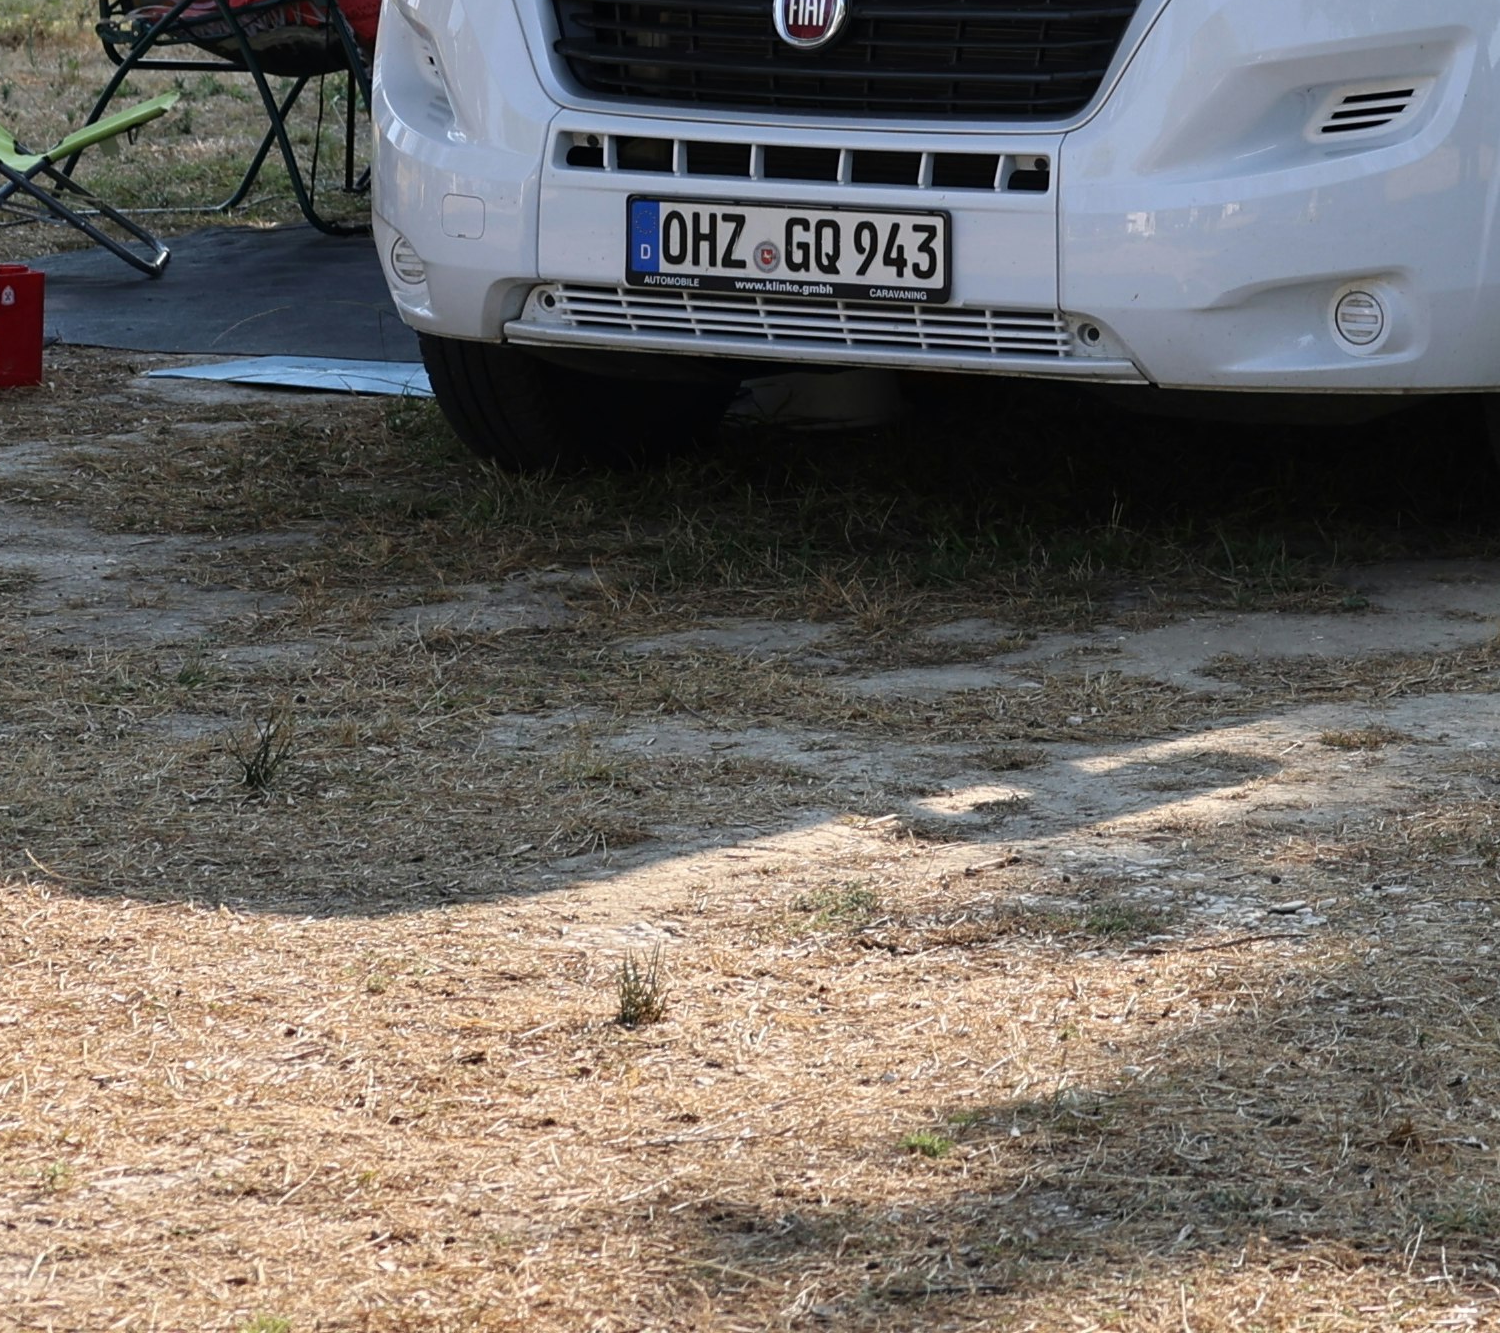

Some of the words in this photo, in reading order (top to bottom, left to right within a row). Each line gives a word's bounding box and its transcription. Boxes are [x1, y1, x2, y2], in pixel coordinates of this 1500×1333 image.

[640, 244, 651, 260] D
[662, 210, 748, 269] OHZ
[784, 217, 842, 275] GQ
[853, 220, 938, 279] 943
[643, 275, 700, 288] AUTOMOBILE
[734, 280, 834, 296] www.klinke.gmbh
[869, 288, 927, 301] CARAVANING
